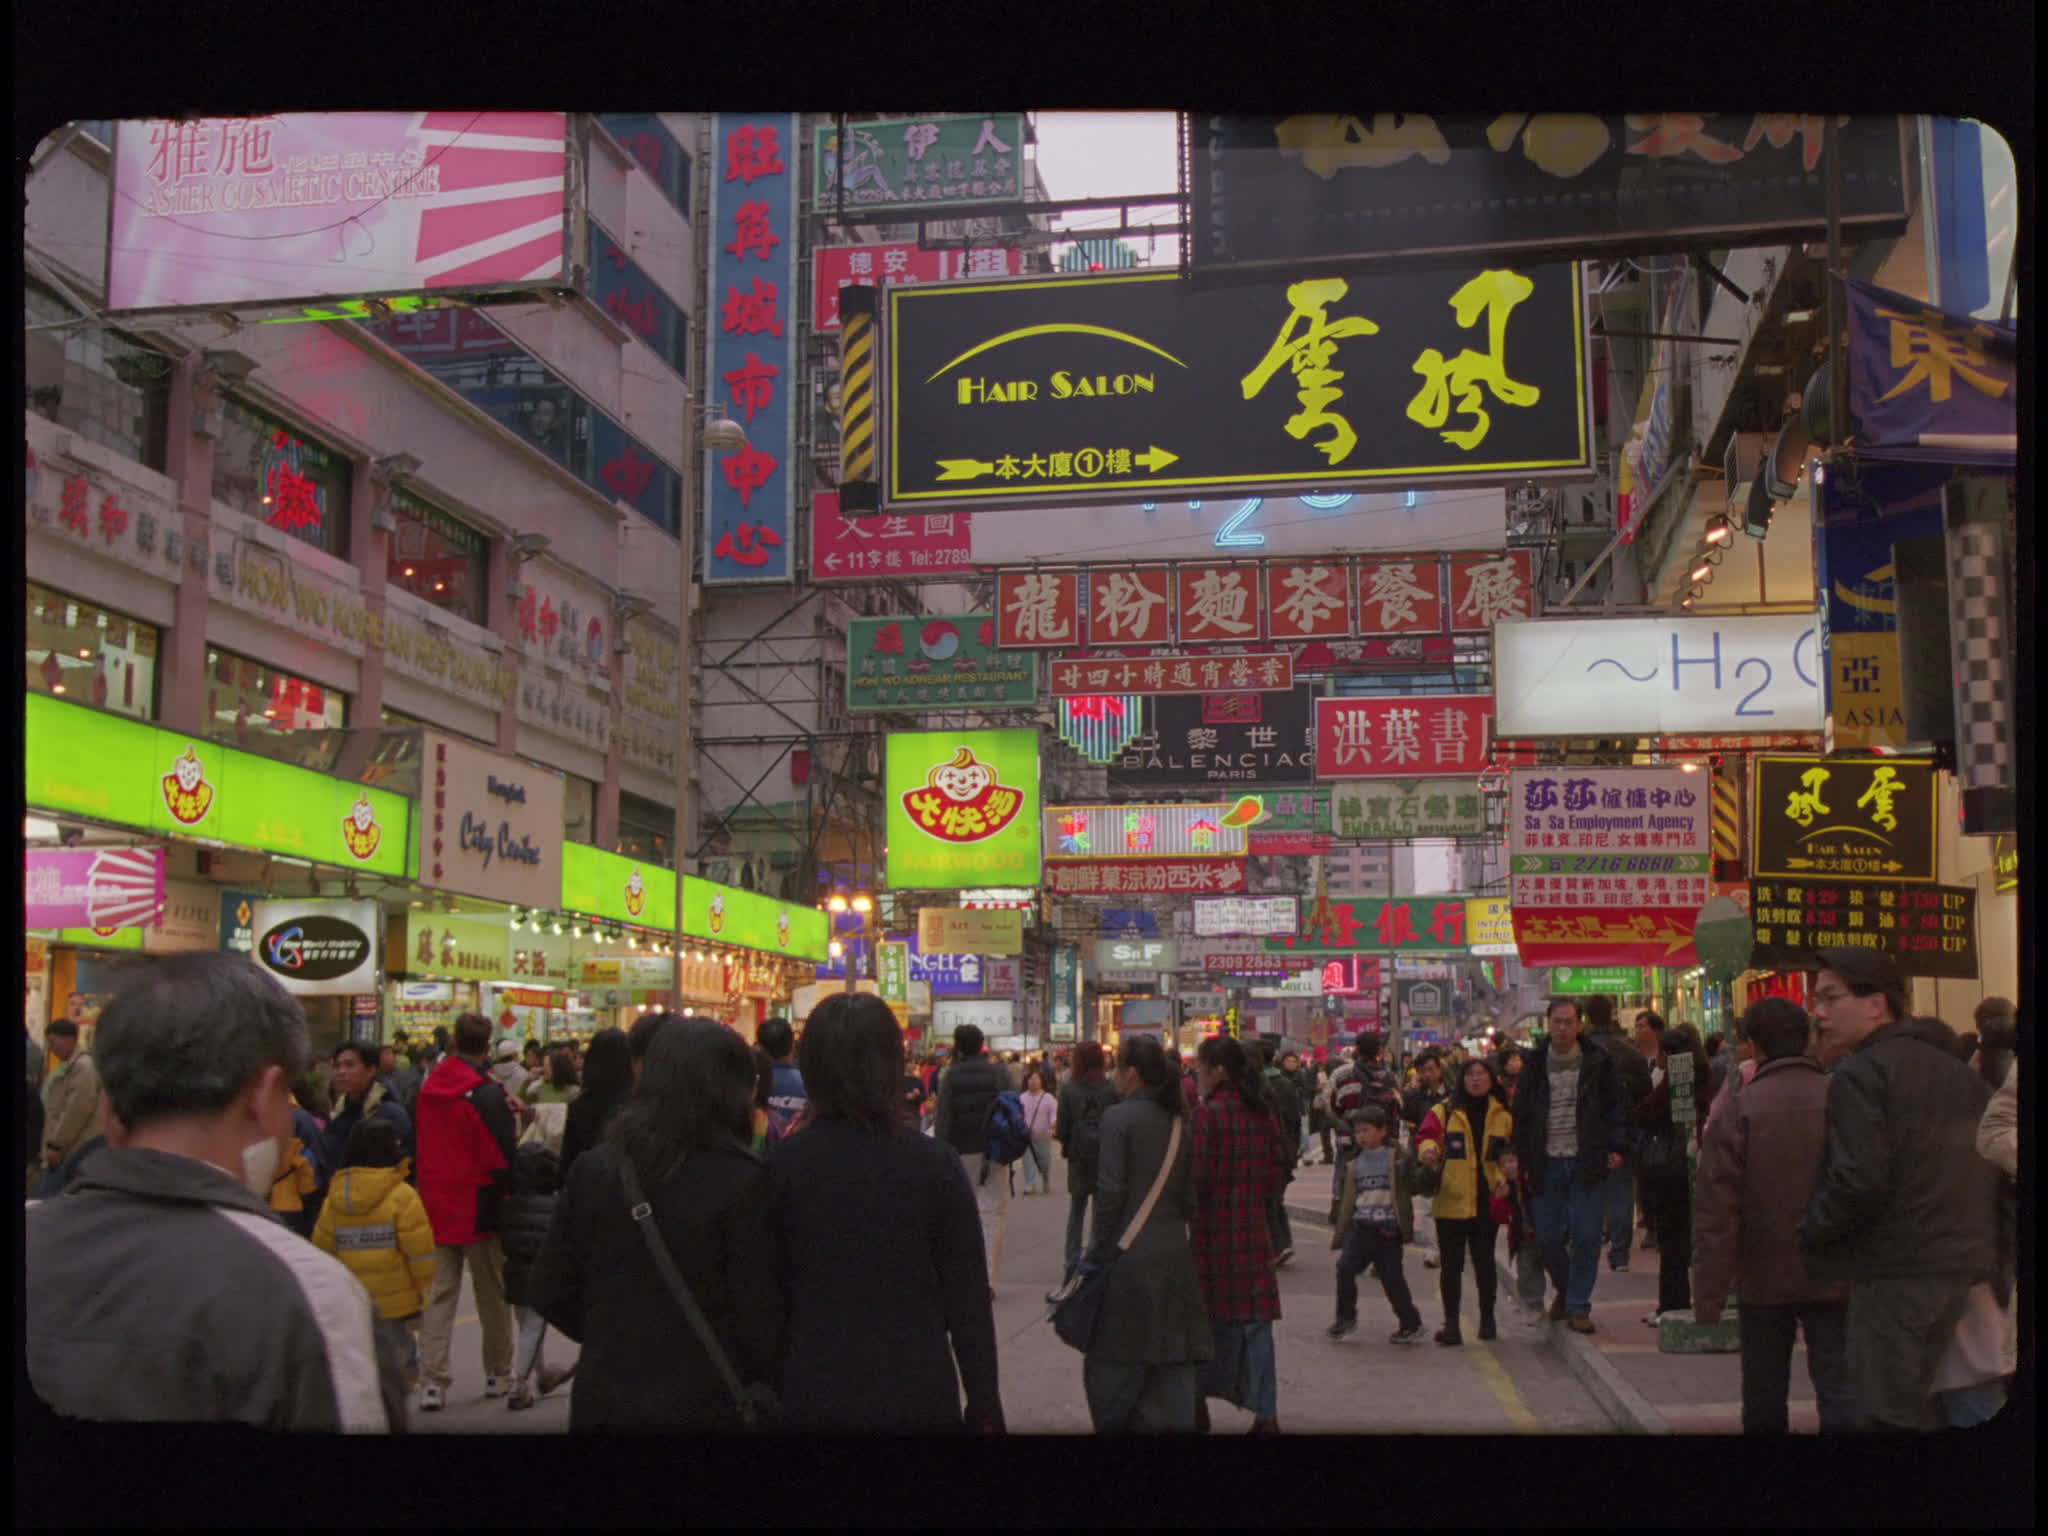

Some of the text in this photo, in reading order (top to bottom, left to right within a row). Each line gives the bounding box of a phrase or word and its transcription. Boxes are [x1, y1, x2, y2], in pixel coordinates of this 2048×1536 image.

[903, 119, 1013, 161] 伊人
[147, 165, 440, 215] ASTER COSMETIC CENTRE
[713, 122, 787, 568] 旺角城市中心
[1873, 307, 2010, 403] 東
[957, 370, 1156, 405] HAIR SALON
[1844, 708, 1906, 727] ASIA
[1206, 769, 1258, 780] PARIS
[909, 789, 1017, 837] 大快活
[1342, 821, 1413, 835] EMERALD
[1524, 814, 1694, 832] Sa Sa Employment Agency
[460, 810, 494, 871] City
[1573, 856, 1622, 872] 2716
[1942, 893, 1966, 910] UP
[1942, 914, 1966, 931] UP
[1942, 935, 1968, 952] UP
[940, 1010, 1009, 1026] Theme
